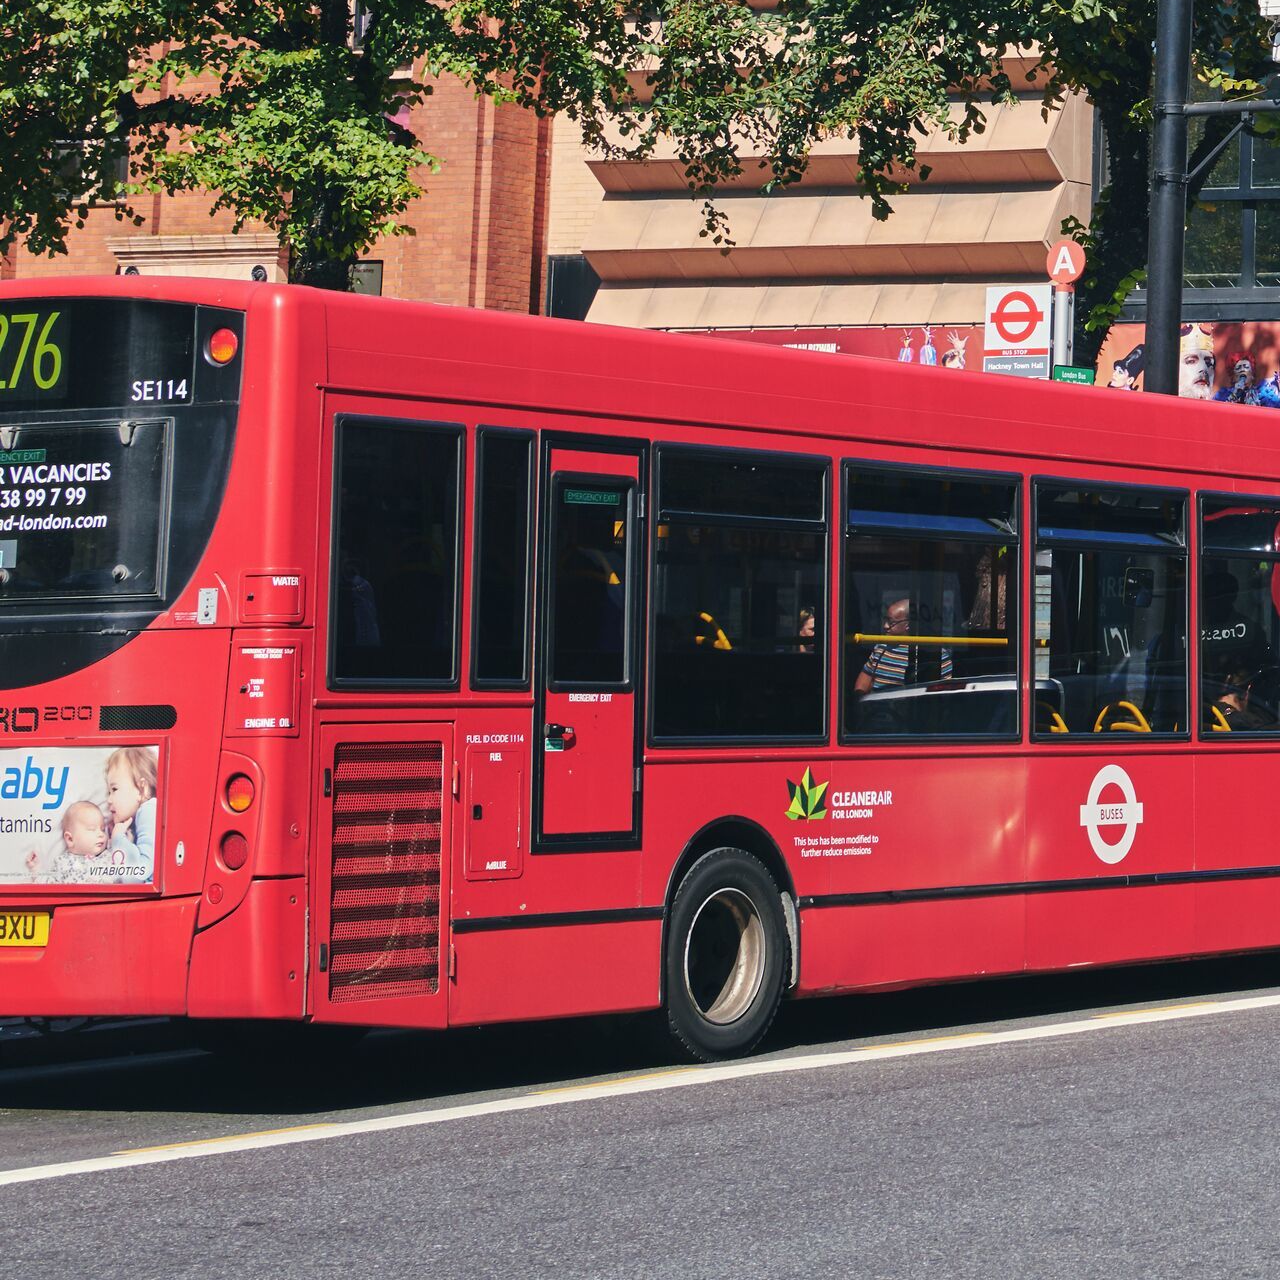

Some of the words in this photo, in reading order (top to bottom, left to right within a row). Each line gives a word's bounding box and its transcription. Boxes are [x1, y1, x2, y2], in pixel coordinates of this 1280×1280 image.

[1052, 246, 1076, 275] A
[988, 363, 1012, 371] Hackney
[1062, 371, 1077, 379] London
[1078, 372, 1086, 380] Bus
[132, 379, 187, 401] SE114
[23, 451, 41, 461] EXIT
[10, 463, 111, 484] VACANCIES
[26, 488, 45, 507] 99
[50, 488, 61, 506] 7
[65, 487, 87, 506] 99
[567, 492, 602, 501] EMERGENCY
[603, 494, 617, 502] EXIT
[272, 577, 299, 586] WATER
[568, 693, 599, 702] EMERGENCY
[600, 693, 612, 702] EXIT
[44, 705, 92, 721] 200
[244, 718, 275, 728] ENGINE
[279, 718, 290, 727] OIL
[466, 735, 482, 743] FUEL
[483, 735, 490, 743] ID
[491, 734, 509, 743] CODE
[510, 734, 524, 743] 1114
[489, 753, 503, 761] FUEL
[832, 791, 892, 807] CLEANERAIR
[832, 810, 845, 819] FOR
[846, 809, 873, 819] LONDON
[1100, 809, 1124, 820] BUSES
[794, 837, 806, 846] This
[807, 837, 819, 846] bus
[820, 836, 830, 845] has
[831, 836, 845, 845] been
[846, 835, 872, 844] modified
[872, 835, 879, 843] to
[801, 848, 822, 858] further
[823, 847, 842, 856] reduce
[843, 847, 872, 856] emissions
[90, 867, 145, 877] VITABIOTICS
